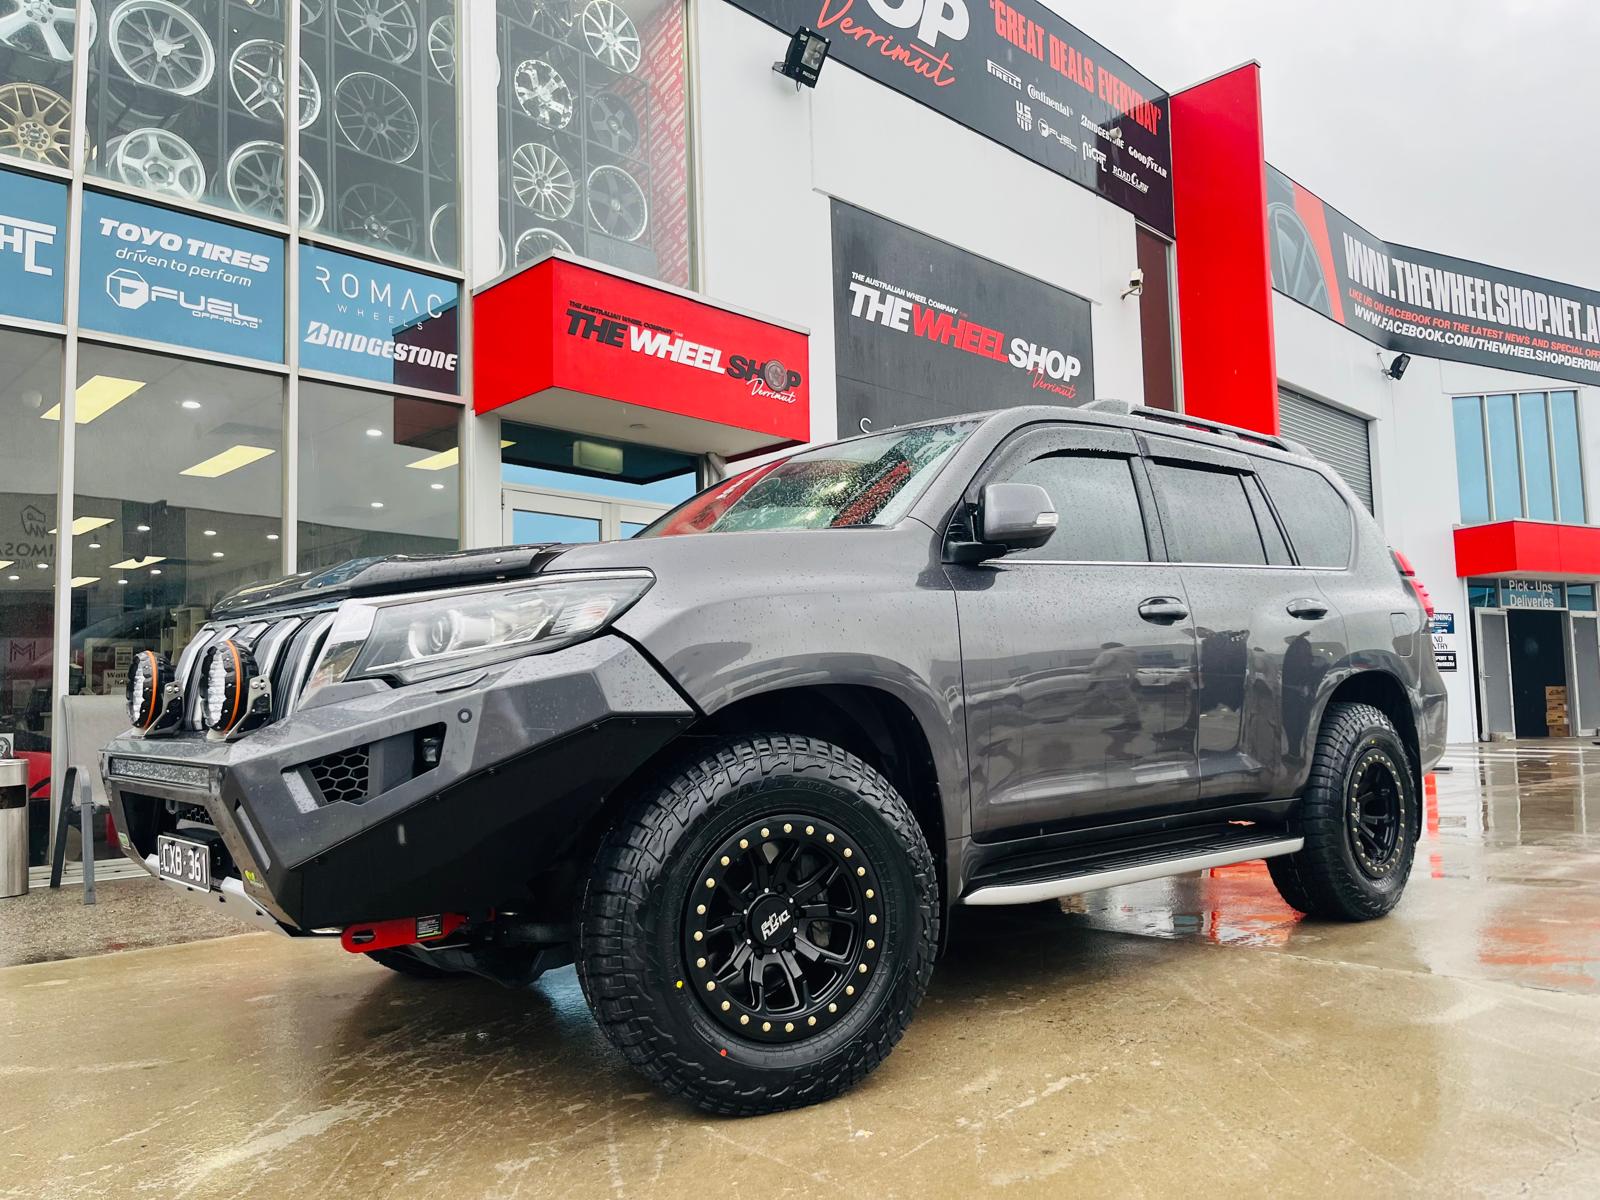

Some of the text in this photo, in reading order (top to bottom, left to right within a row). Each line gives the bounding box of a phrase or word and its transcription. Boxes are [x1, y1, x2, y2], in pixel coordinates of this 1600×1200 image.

[987, 59, 1022, 91] PIRELLI
[1049, 34, 1095, 94] DEALS
[1027, 84, 1070, 118] Continental
[1128, 146, 1167, 178] GOODYEAR
[100, 217, 270, 273] TOYO TIRES
[115, 247, 252, 288] driven to perform
[151, 285, 258, 323] FUEL
[315, 265, 443, 319] ROMAC
[569, 300, 582, 309] THE
[851, 271, 865, 282] THE
[865, 277, 906, 297] AUSTRALIAN
[906, 290, 927, 305] WHEEL
[927, 299, 958, 315] COMPANY
[191, 310, 259, 329] OFF-ROAD
[337, 304, 423, 331] WHEELS
[849, 281, 1081, 382] THE WHEEL SHOP
[1348, 288, 1362, 303] LIKE
[1363, 294, 1373, 307] US
[1373, 300, 1384, 313] ON
[1384, 305, 1432, 326] FACEBOOK
[1432, 317, 1451, 330] FOR
[1453, 321, 1470, 333] THE
[1471, 325, 1503, 340] LATEST
[1505, 332, 1530, 346] NEWS
[1531, 337, 1550, 349] AND
[1551, 340, 1584, 356] SPECIAL
[303, 320, 458, 372] BRIDGESTONE
[566, 308, 802, 391] THE WHEEL SHOP
[746, 378, 797, 404] Derrimut
[1510, 594, 1554, 608] Deliveries
